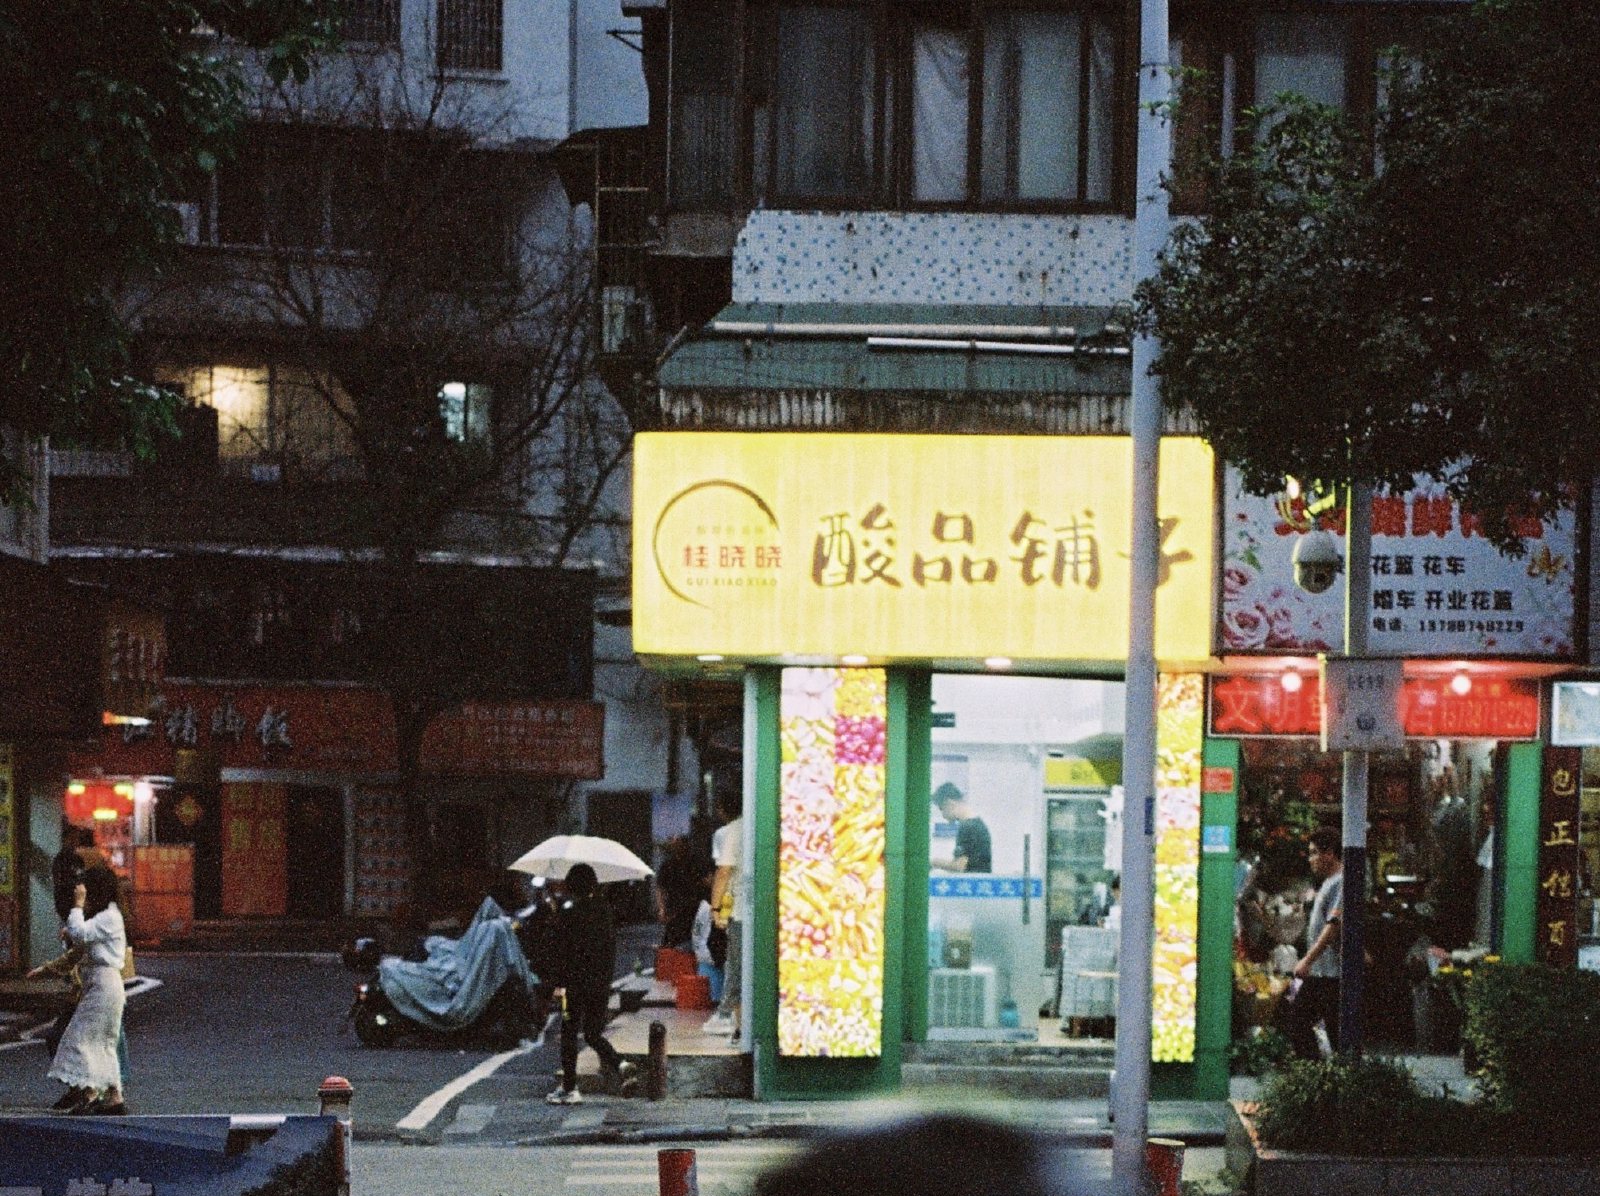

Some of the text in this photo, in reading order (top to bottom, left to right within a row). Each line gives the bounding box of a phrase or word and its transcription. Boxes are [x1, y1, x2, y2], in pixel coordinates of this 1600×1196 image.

[684, 544, 782, 568] 桂晓晓
[811, 502, 1195, 591] 酸品铺子
